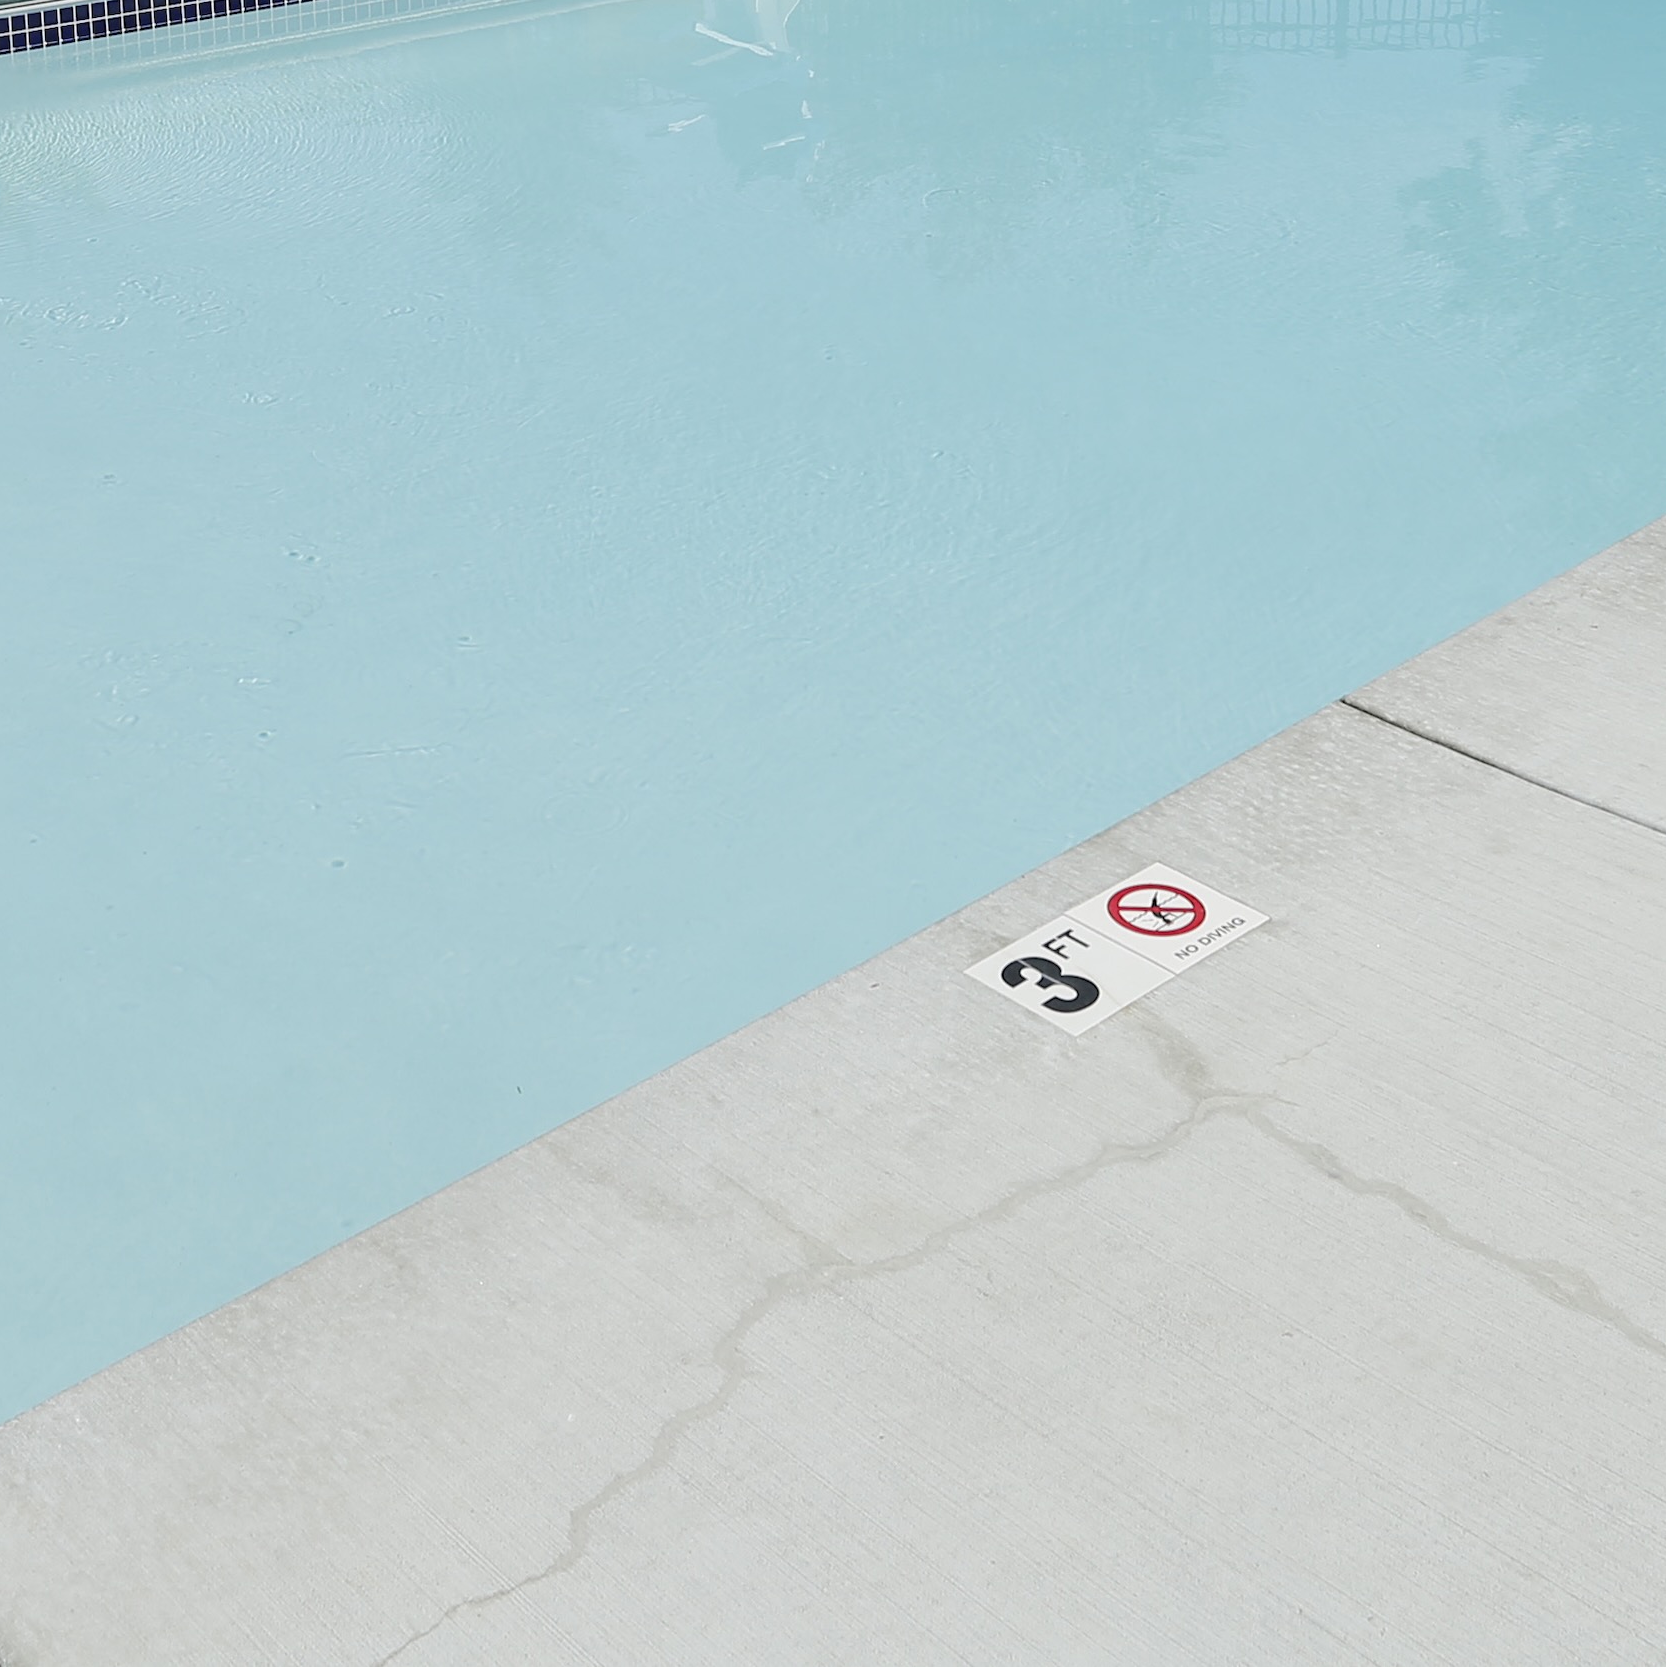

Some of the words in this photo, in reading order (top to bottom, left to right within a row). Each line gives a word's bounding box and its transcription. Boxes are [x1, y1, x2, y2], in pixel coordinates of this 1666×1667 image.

[1042, 929, 1090, 961] FT
[1174, 944, 1199, 960] NO
[1197, 917, 1247, 946] DIVING
[1000, 956, 1100, 1014] 3
